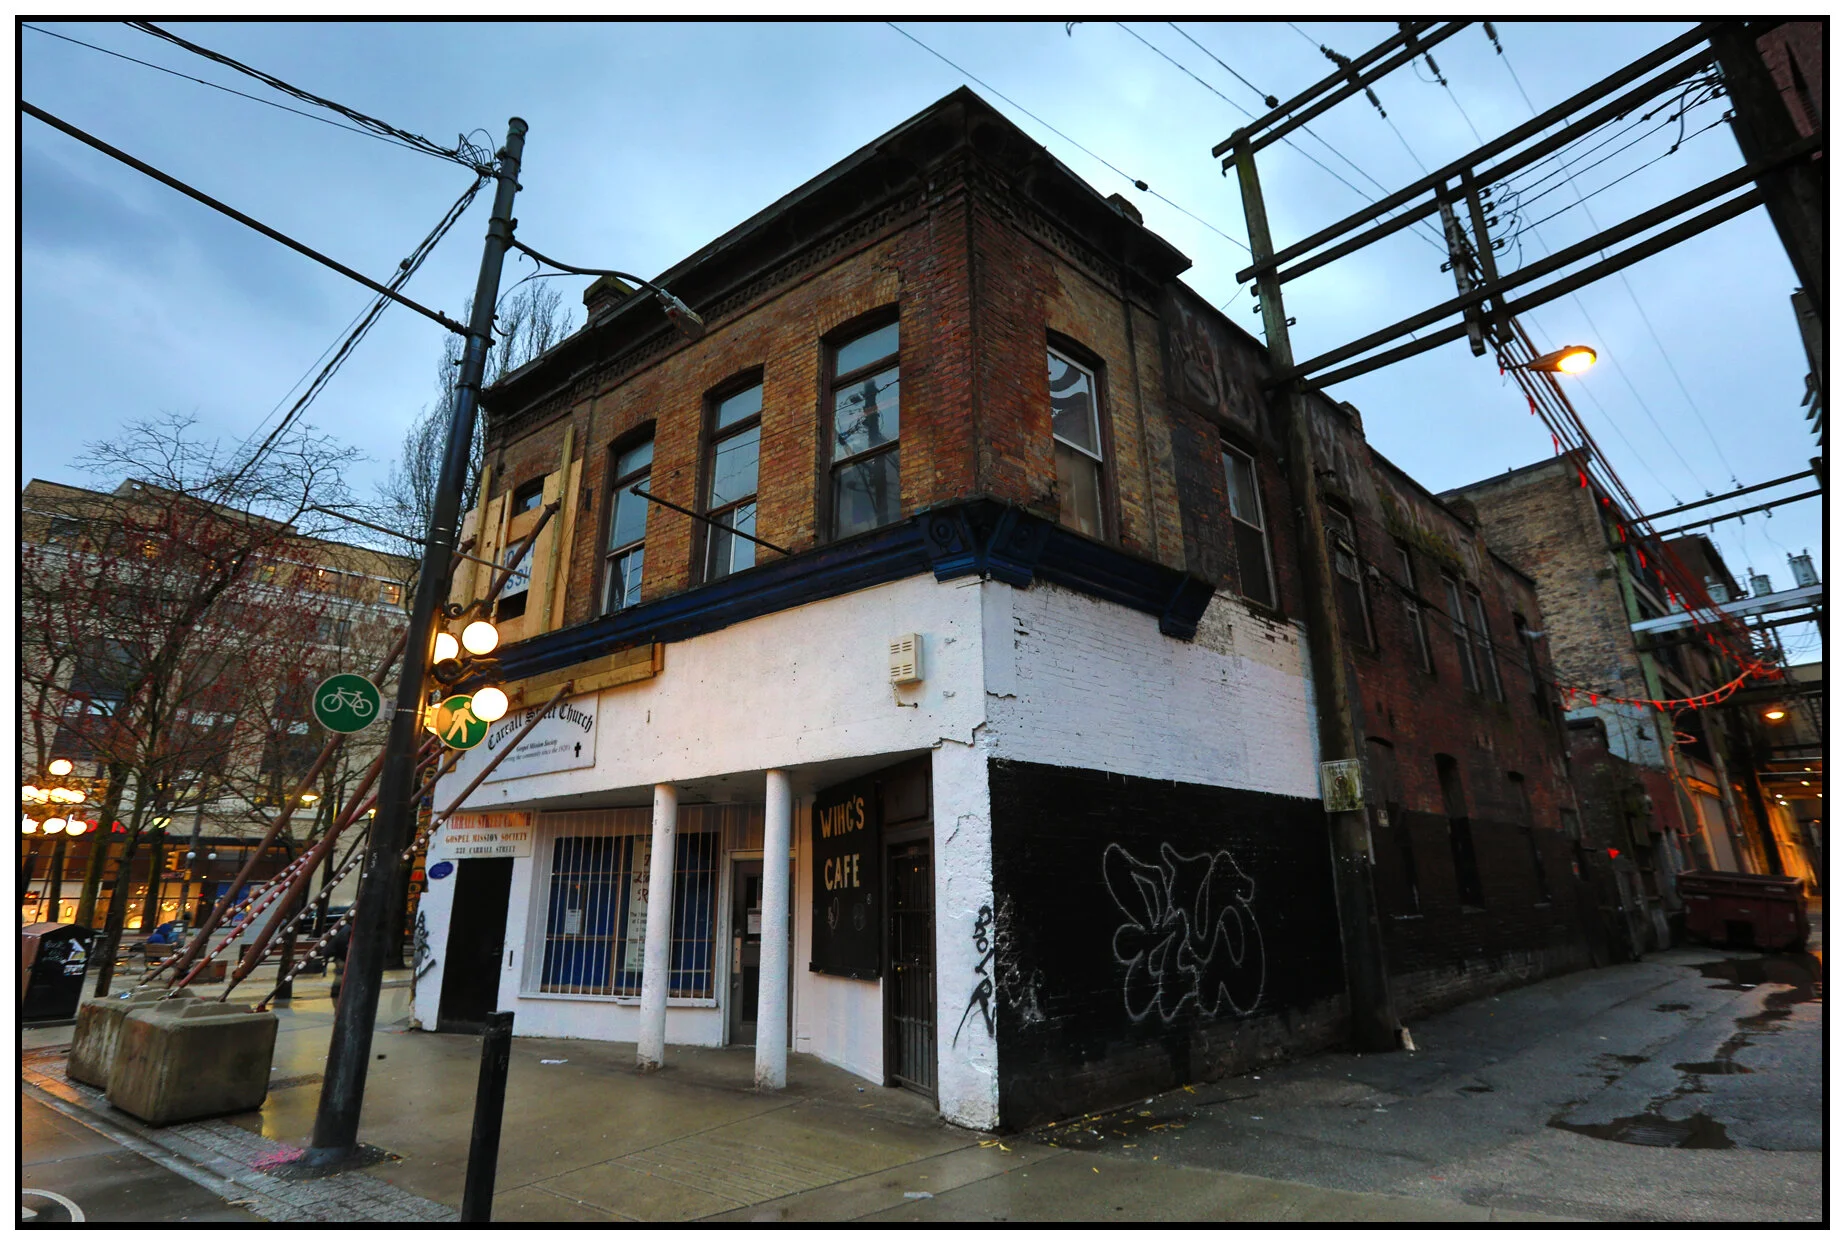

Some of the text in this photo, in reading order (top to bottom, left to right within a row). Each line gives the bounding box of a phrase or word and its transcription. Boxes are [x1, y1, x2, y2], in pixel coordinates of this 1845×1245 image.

[488, 703, 593, 750] Carrall Seet Church
[445, 832, 527, 844] GOSPEL MISSION SOCIETY
[469, 846, 492, 854] CARRALL
[495, 845, 516, 853] STREET
[824, 853, 860, 892] CAFE
